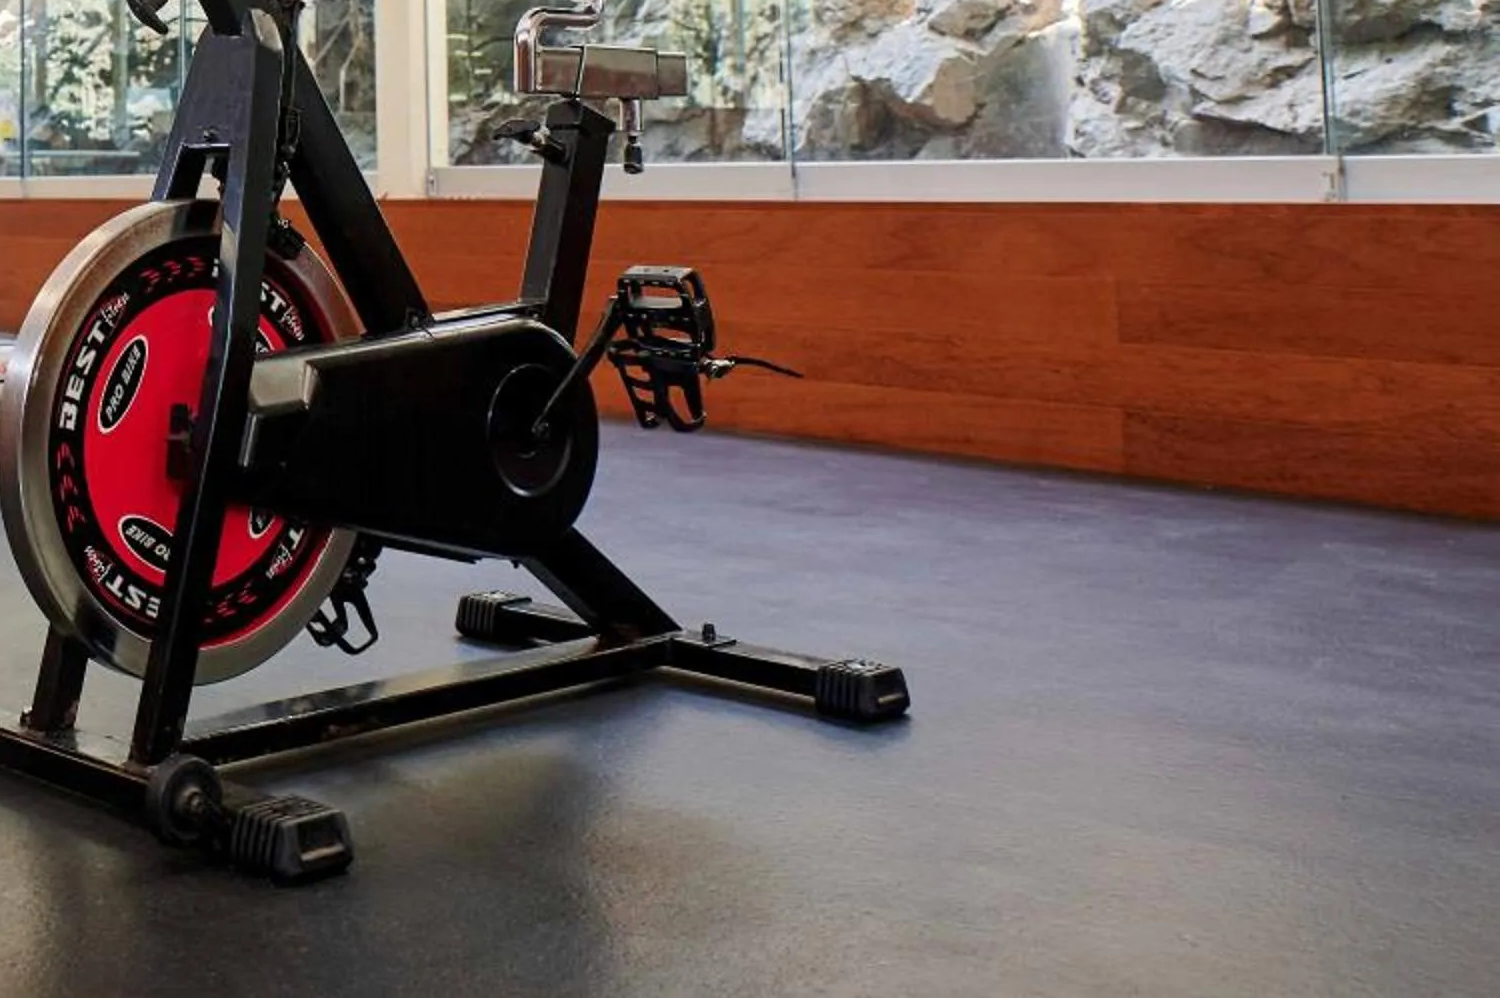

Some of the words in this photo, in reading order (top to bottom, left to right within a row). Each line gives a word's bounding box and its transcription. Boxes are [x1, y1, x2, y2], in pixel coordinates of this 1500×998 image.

[58, 320, 106, 431] BEST
[105, 383, 125, 422] PRO
[121, 343, 142, 385] BIKE
[124, 524, 157, 549] BIKE
[105, 574, 161, 619] EST
